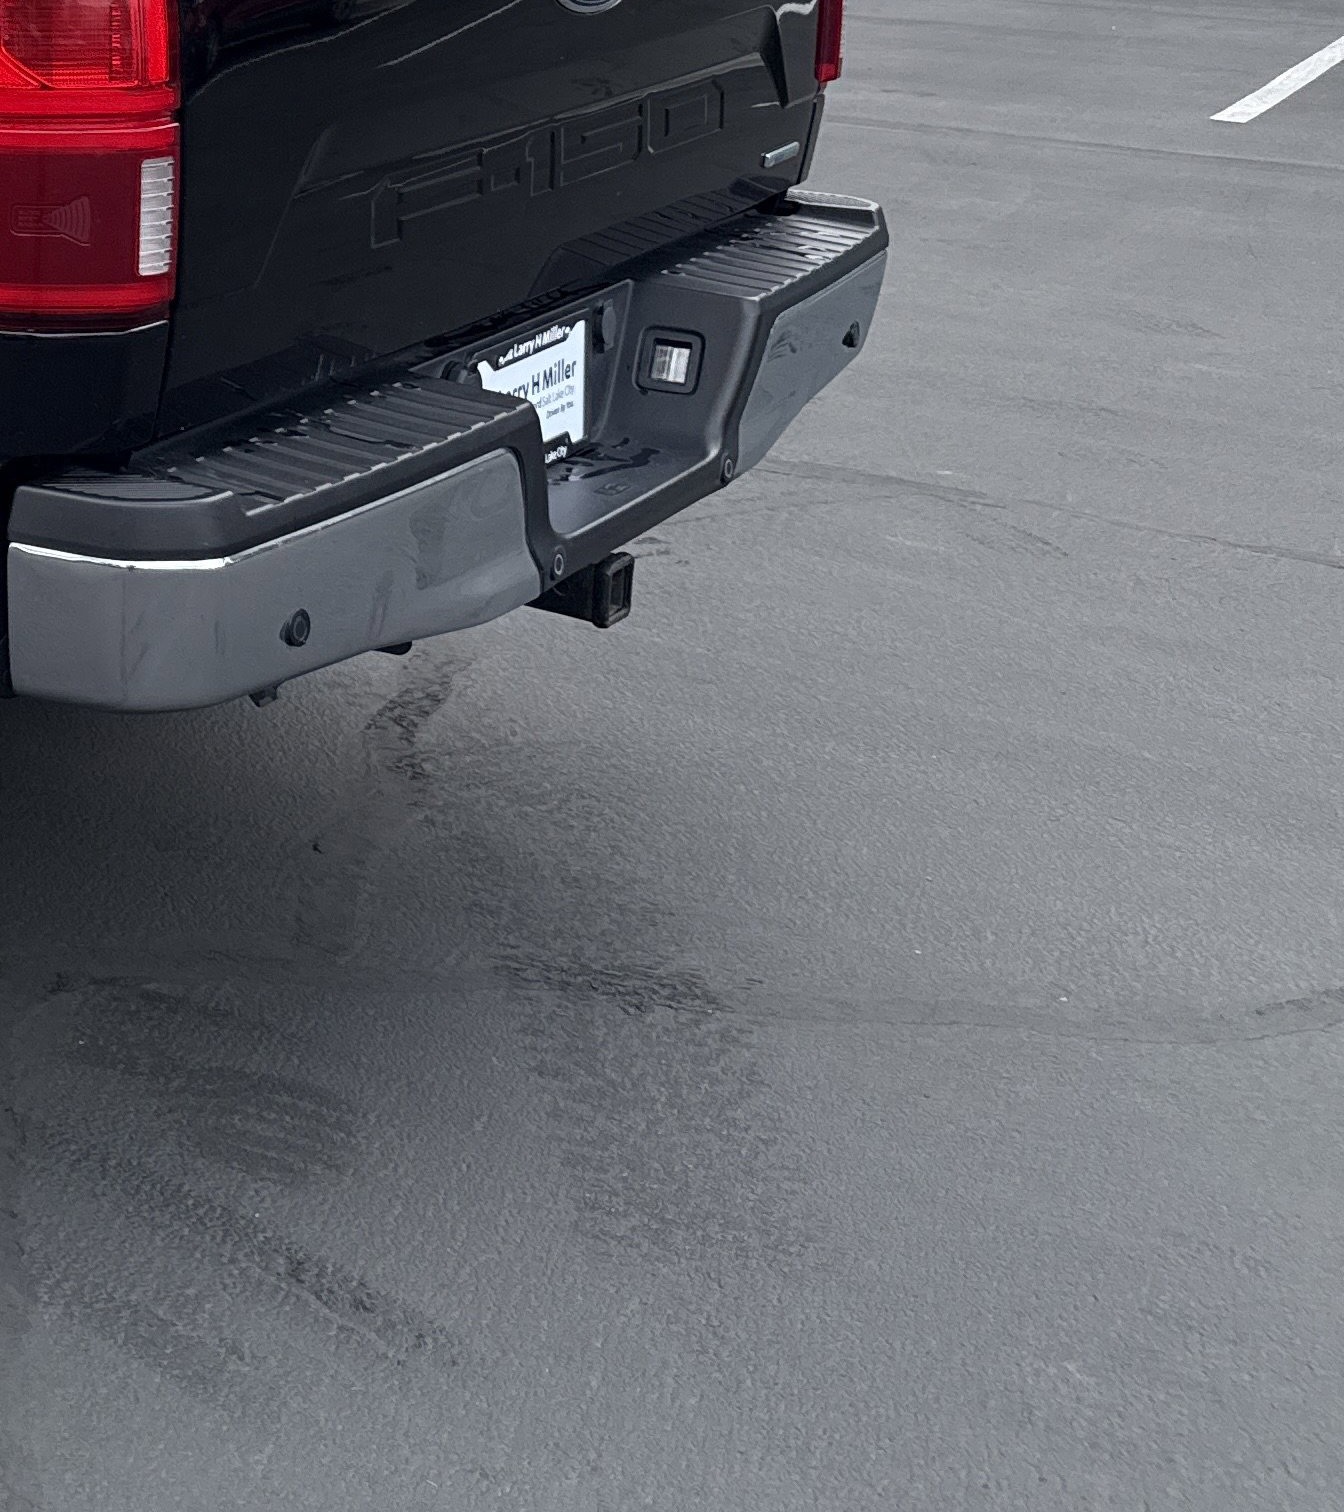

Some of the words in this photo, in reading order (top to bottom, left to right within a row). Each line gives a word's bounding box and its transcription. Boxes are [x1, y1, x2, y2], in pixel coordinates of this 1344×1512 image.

[513, 340, 534, 356] Larry
[542, 325, 565, 343] Miller
[498, 382, 529, 399] arry
[531, 372, 540, 395] H
[541, 358, 576, 391] Miller
[544, 450, 557, 464] Lake
[556, 445, 568, 458] City
